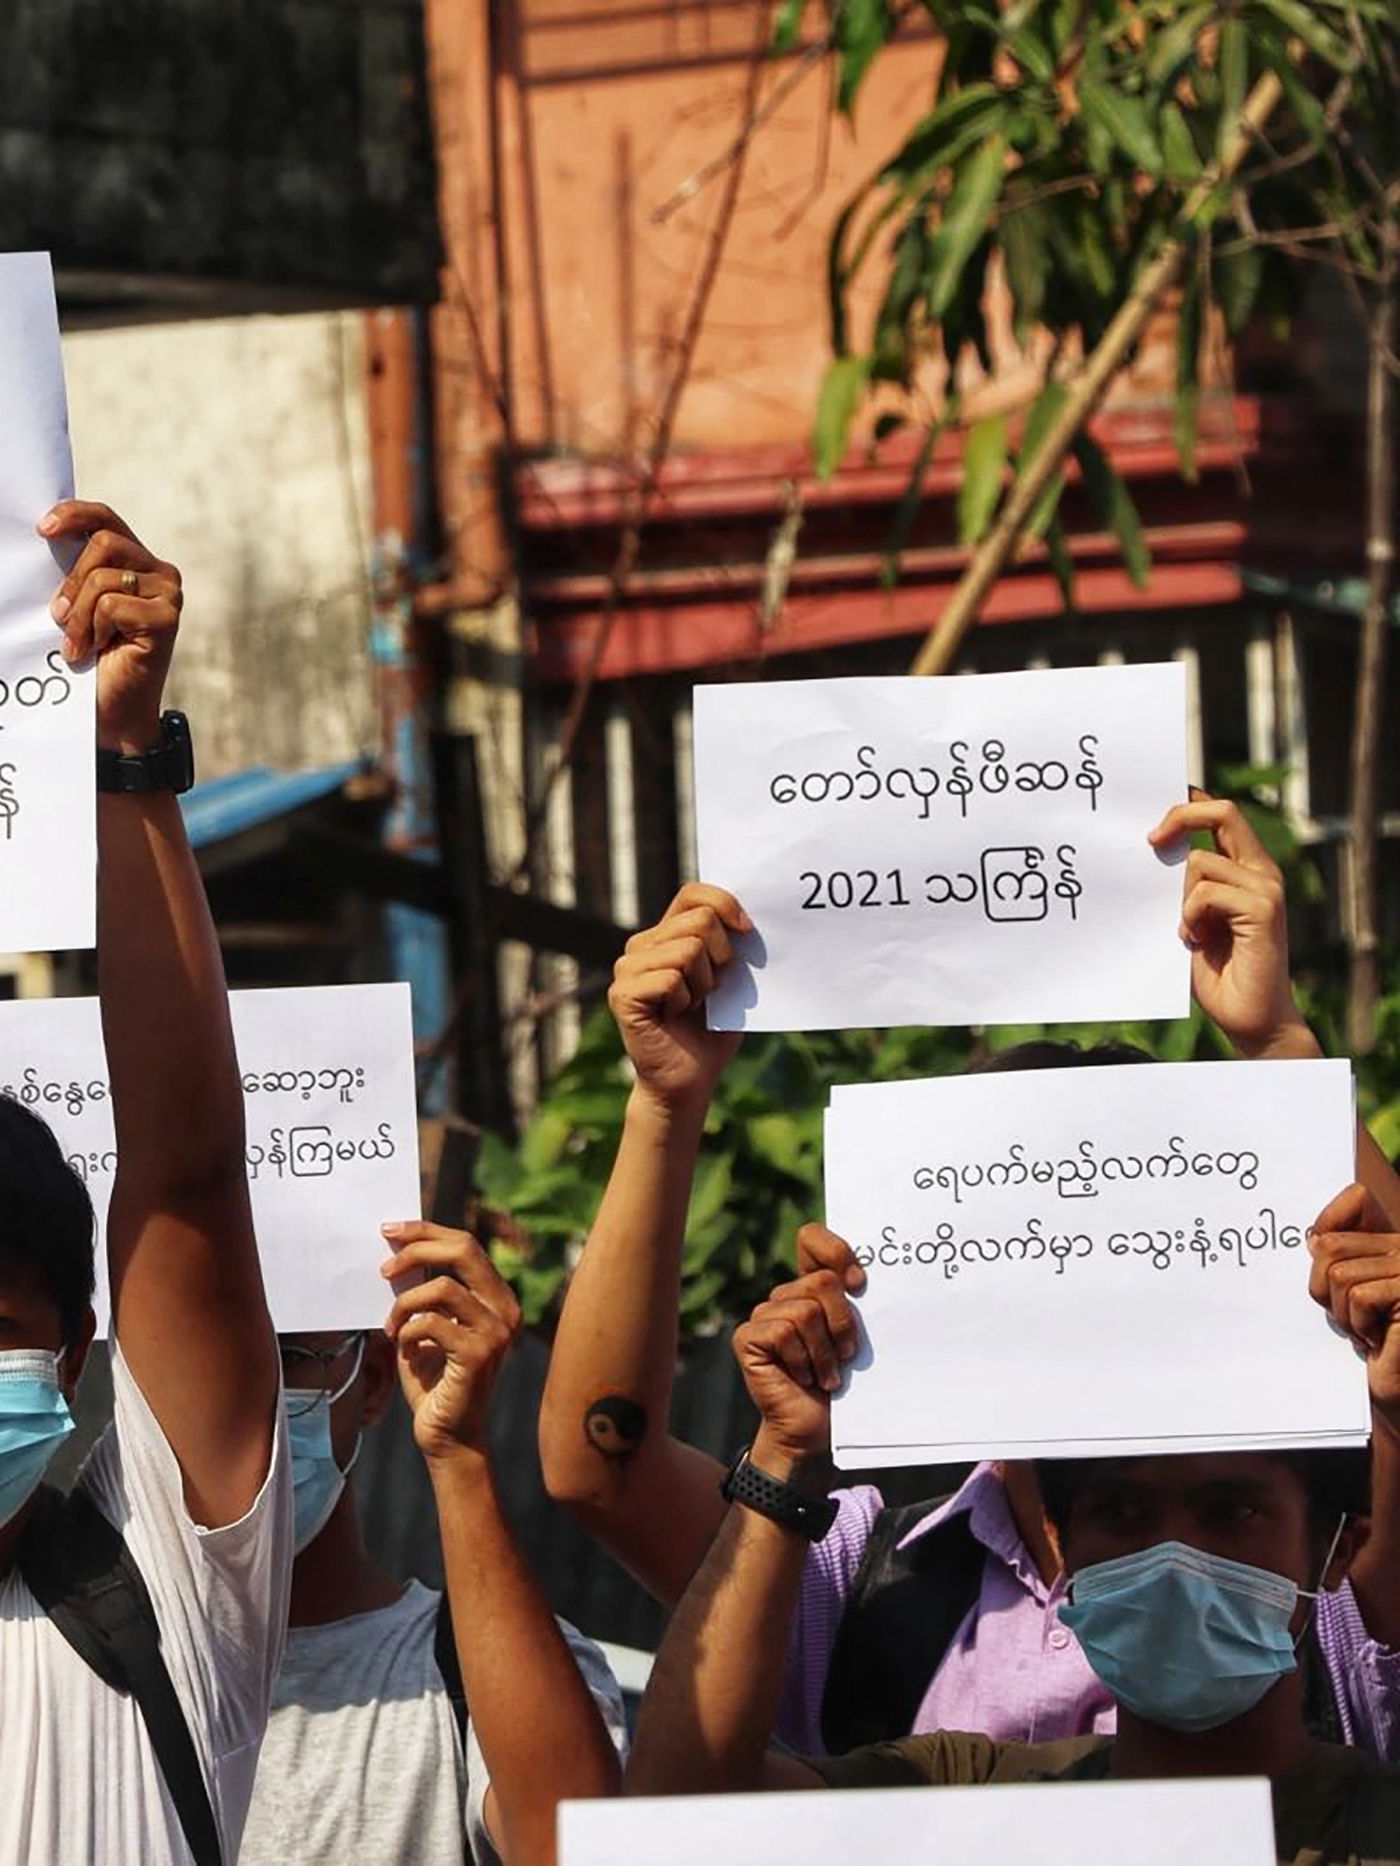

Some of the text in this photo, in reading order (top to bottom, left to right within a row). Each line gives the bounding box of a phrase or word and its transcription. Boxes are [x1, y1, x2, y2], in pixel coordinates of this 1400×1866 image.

[769, 734, 1104, 820] တော်လှန်ဖီဆန်
[799, 844, 1083, 921] 2021 သင်္ကြန်
